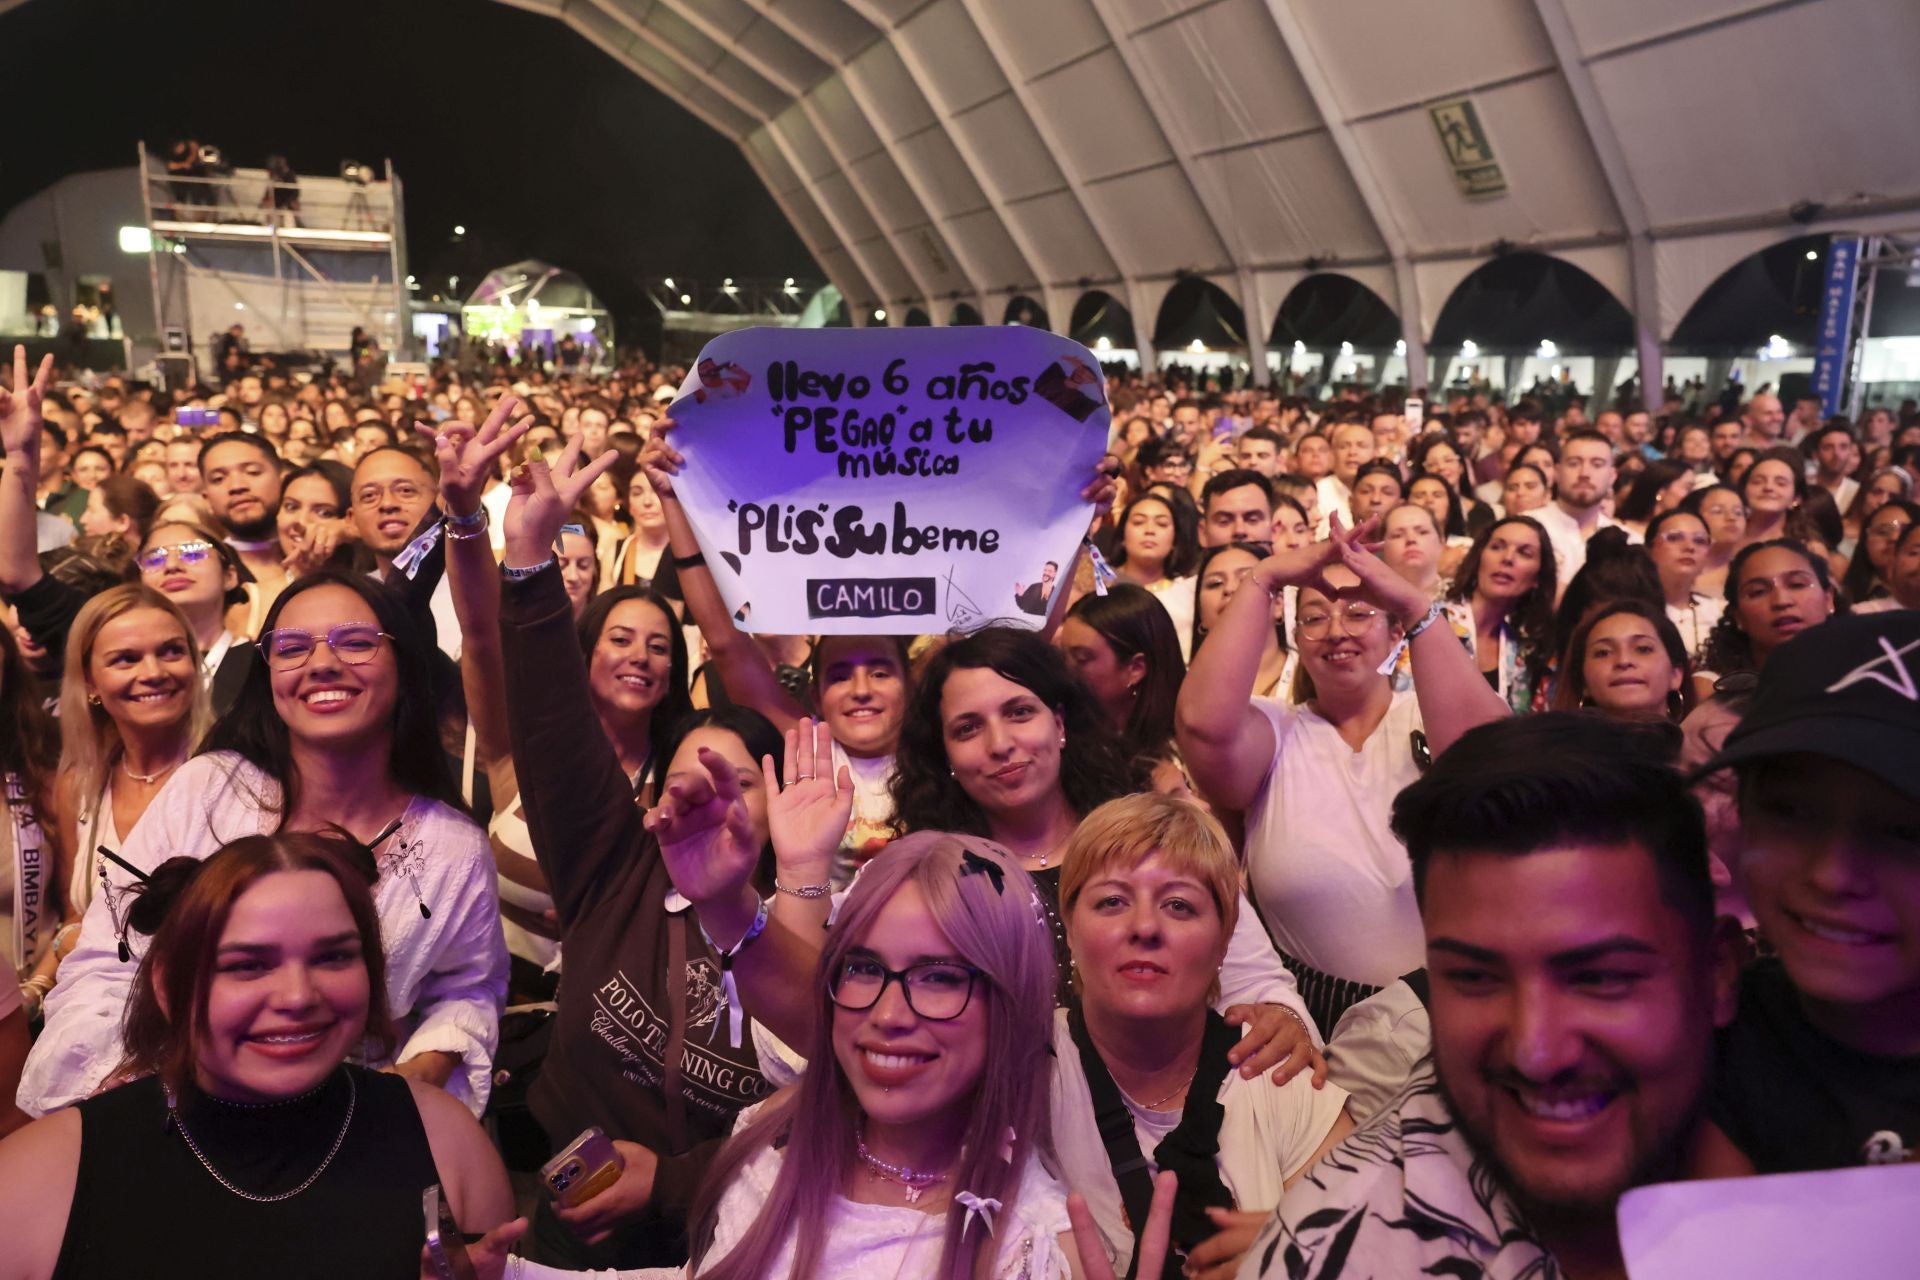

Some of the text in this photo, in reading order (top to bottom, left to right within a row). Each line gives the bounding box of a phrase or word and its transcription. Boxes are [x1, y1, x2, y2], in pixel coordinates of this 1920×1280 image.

[767, 359, 1034, 406] llevo 6 años
[909, 418, 933, 444] a
[944, 407, 994, 445] tu
[838, 446, 960, 478] música
[817, 584, 922, 611] CAMILO
[600, 978, 645, 1028] POLO
